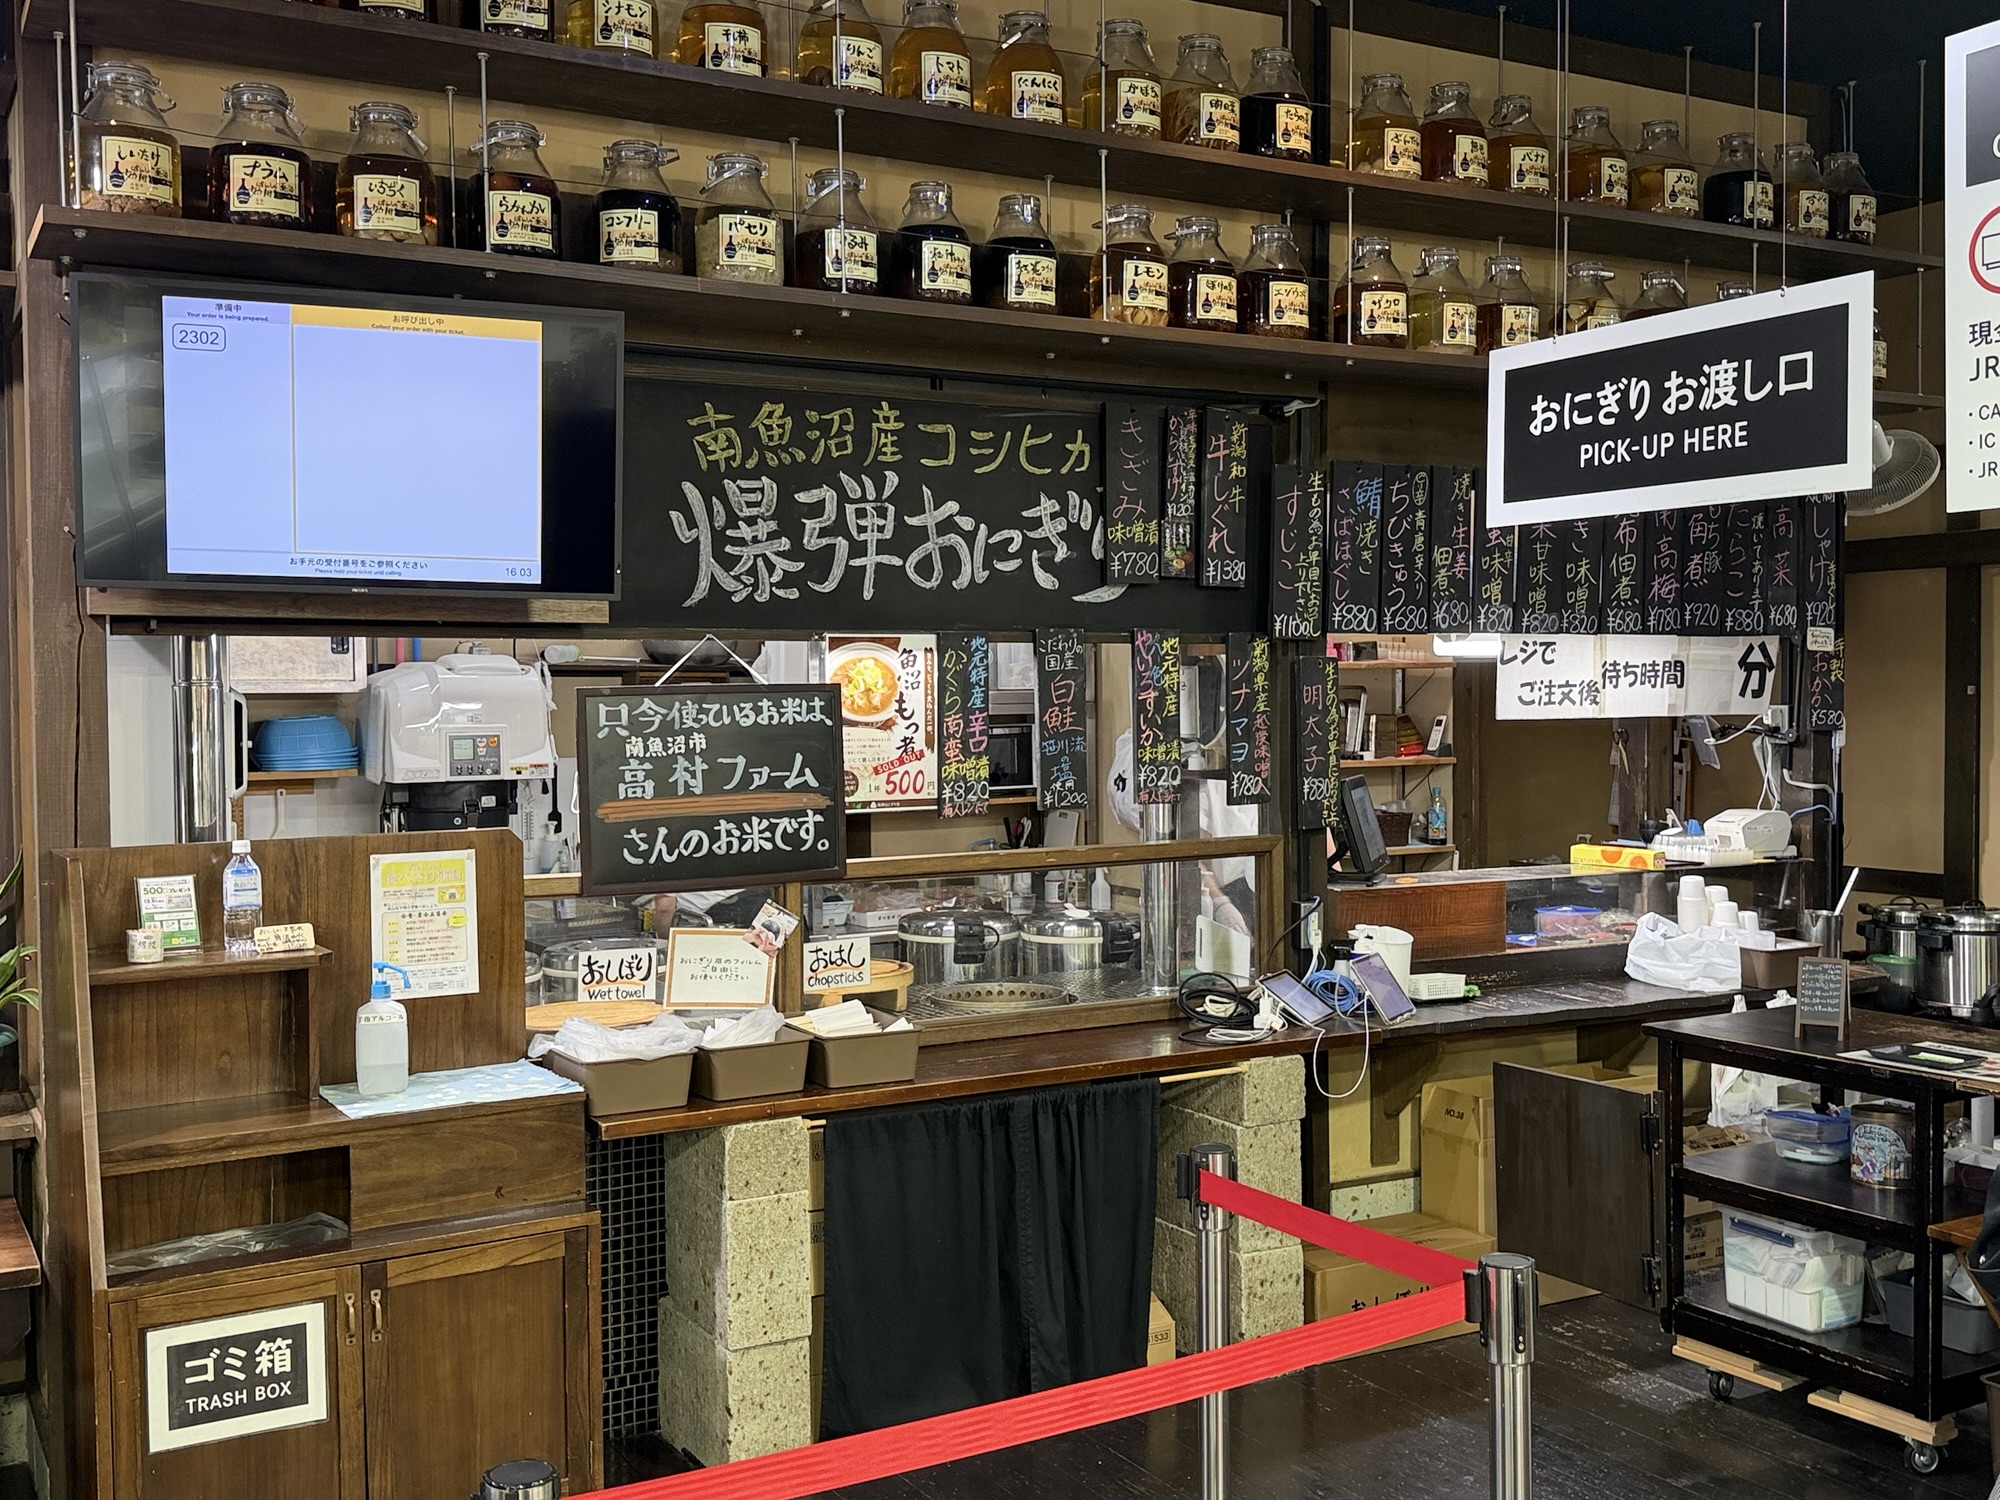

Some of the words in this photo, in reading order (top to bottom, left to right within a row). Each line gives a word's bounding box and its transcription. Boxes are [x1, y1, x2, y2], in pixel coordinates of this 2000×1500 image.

[602, 1, 647, 18] シナモン
[846, 43, 876, 59] りんご
[935, 56, 964, 73] トマト
[1017, 78, 1059, 92] にんにく
[117, 145, 161, 166] しいたけ
[241, 162, 288, 182] プラム
[603, 213, 649, 230] コンフリー
[727, 220, 767, 237] パセリ
[1133, 264, 1164, 280] レモン
[187, 311, 201, 319] Your
[214, 302, 243, 314] 準備中
[1371, 294, 1401, 310] ザクロ
[371, 323, 391, 332] Collect
[392, 314, 445, 326] お呼び出し中
[178, 329, 220, 346] 2302
[1528, 376, 1651, 438] おにぎり
[1663, 349, 1815, 414] お渡し口
[1579, 431, 1675, 469] PICK-UP
[1683, 420, 1750, 455] HERE
[1979, 432, 1996, 450] IC
[1113, 417, 1149, 521] きざみ
[1228, 420, 1249, 514] 新潟和牛
[1978, 461, 1998, 478] JR
[1206, 434, 1236, 555] 牛しぐれ
[1107, 518, 1159, 547] 味噌漬
[1276, 484, 1303, 590] すじこ
[1450, 472, 1472, 581] 焼き生姜
[1332, 487, 1353, 601] さばほぐし
[1386, 480, 1413, 609] ちびきゅう
[1683, 512, 1709, 589] 角煮
[1726, 504, 1750, 599] たらこ
[1771, 504, 1794, 587] 高菜
[1809, 505, 1832, 596] しゃけ
[289, 557, 429, 571] お手元の受付番号をご参照ください
[1431, 544, 1455, 598] 佃煮
[1749, 513, 1765, 614] 焼いてあります
[1331, 601, 1378, 633] ¥880
[1477, 603, 1514, 633] ¥820
[1521, 607, 1559, 634] ¥820
[1560, 608, 1599, 634] ¥820
[1683, 602, 1720, 627] ¥920
[1725, 608, 1764, 633] ¥880
[1038, 638, 1083, 656] こだわりの
[1499, 639, 1558, 667] レジで
[969, 634, 989, 710] 地元特産
[1044, 652, 1079, 671] 国産
[1251, 635, 1271, 713] 新潟県産
[1601, 659, 1686, 690] 待ち時間
[1737, 640, 1776, 700] 分
[1135, 630, 1163, 747] やいろすいか
[1161, 636, 1181, 718] 地元特産
[941, 648, 966, 762] かぐら南蛮
[1042, 675, 1084, 738] 白鮭
[1517, 679, 1601, 707] ご注文後
[597, 696, 834, 738] 只今使っているお米は、
[1230, 657, 1252, 765] ツナマヨ
[965, 710, 989, 754] 辛口
[1302, 684, 1325, 774] 明太子
[624, 732, 708, 758] 南魚沼市
[617, 753, 709, 800] 高村
[717, 752, 820, 791] ファーム
[876, 758, 901, 774] SOLD
[903, 750, 923, 766] OUT
[1137, 764, 1181, 787] ¥820
[884, 768, 926, 796] 500
[926, 781, 936, 791] 円
[941, 780, 990, 802] ¥820
[1229, 772, 1260, 798] ¥780
[1302, 775, 1330, 801] ¥880
[621, 809, 831, 867] さんのお米です。
[143, 886, 163, 896] 500
[581, 951, 653, 986] おしぼり
[680, 956, 762, 965] おにぎり用のフィルム
[701, 964, 739, 973] ご自由に
[808, 942, 866, 974] おはし
[614, 984, 646, 999] towel
[690, 973, 749, 982] お使いください
[184, 1337, 293, 1387] ゴミ箱
[186, 1386, 248, 1415] TRASH
[255, 1380, 292, 1402] BOX
